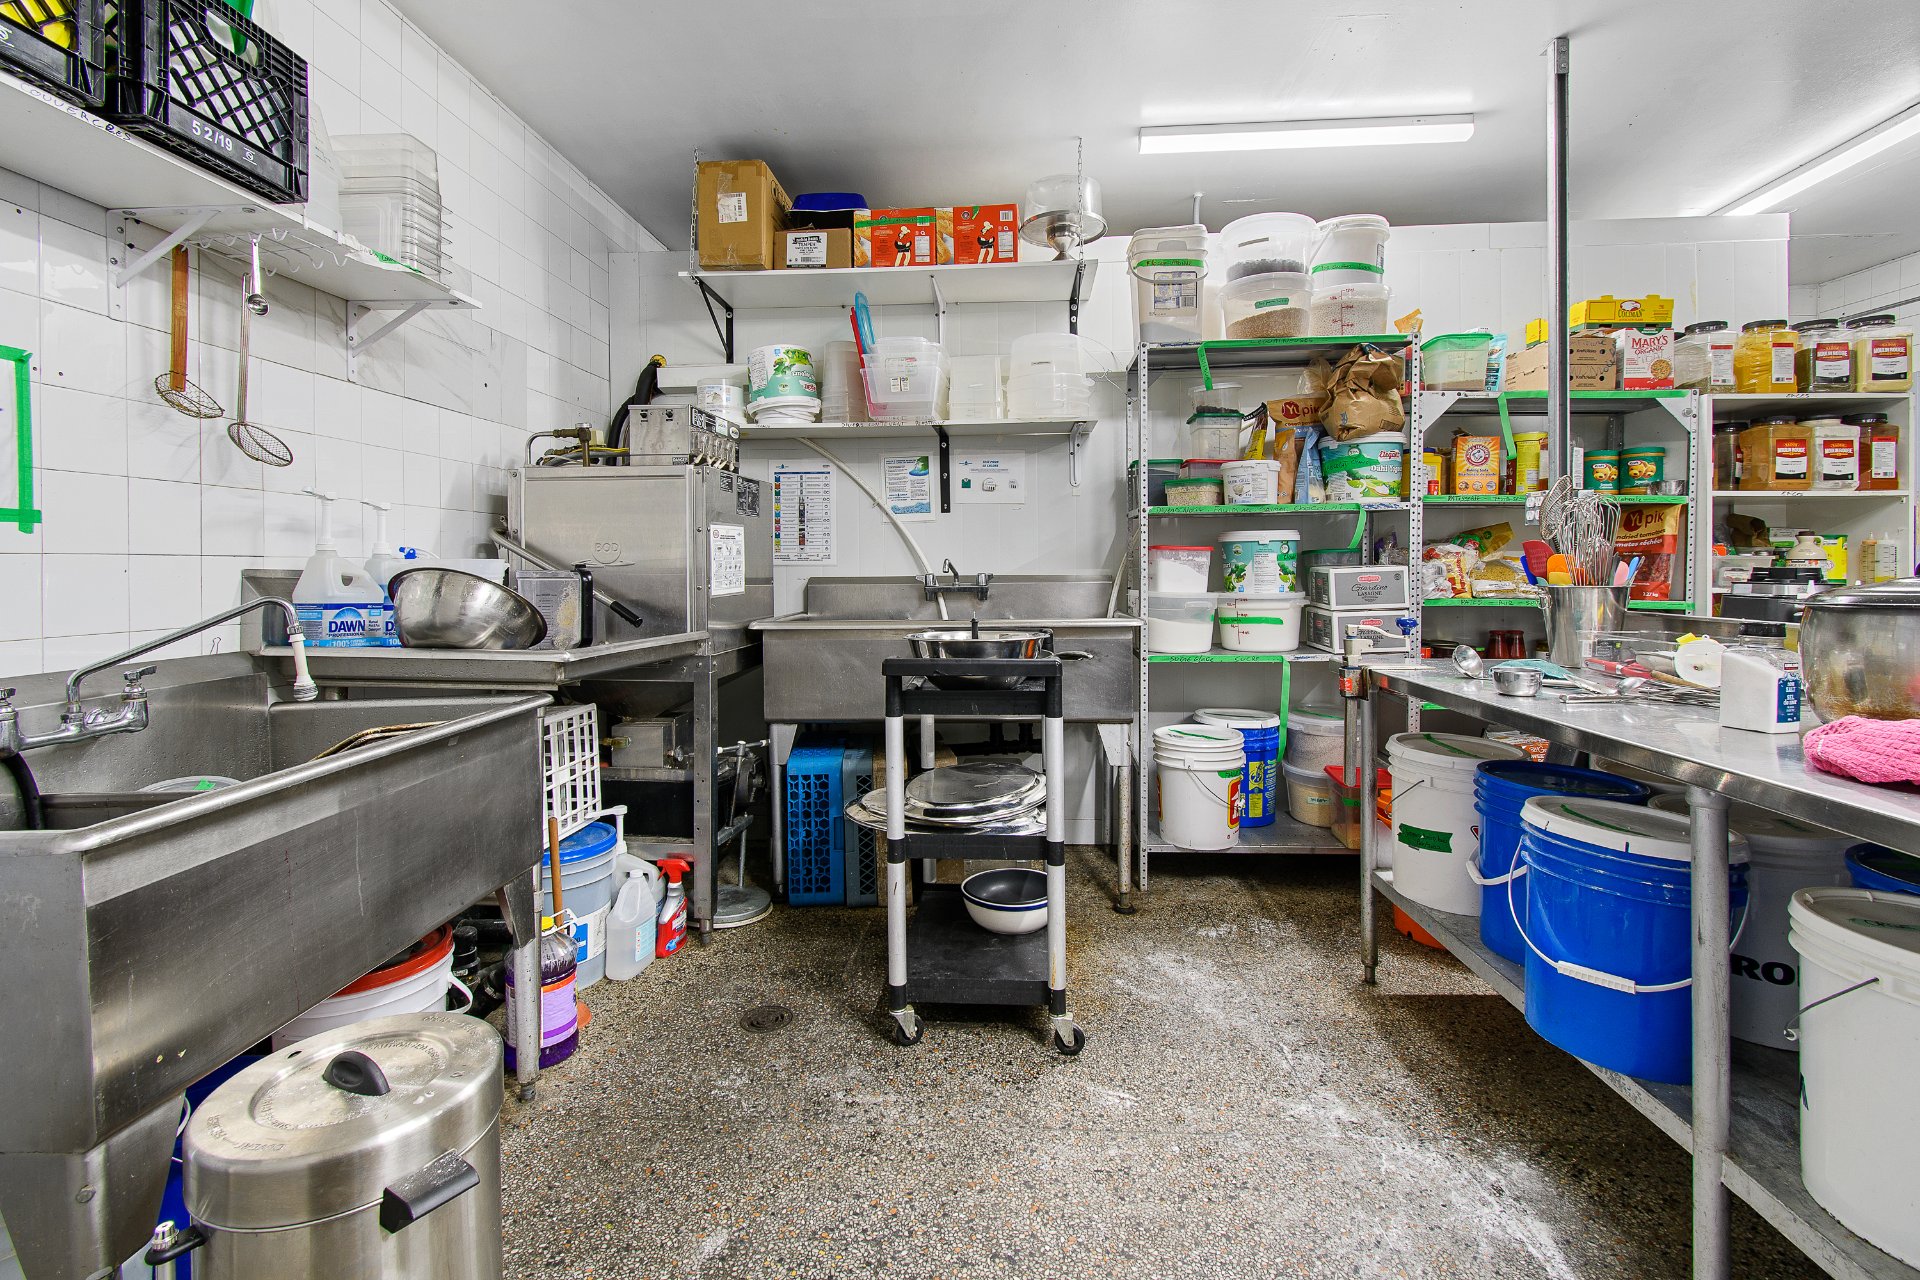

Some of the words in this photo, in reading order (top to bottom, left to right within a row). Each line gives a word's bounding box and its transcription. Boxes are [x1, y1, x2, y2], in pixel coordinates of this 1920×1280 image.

[1631, 335, 1668, 348] MARY'S
[1634, 346, 1664, 355] ORGANIC
[1639, 528, 1666, 538] tomatoes
[328, 619, 366, 633] DAWN
